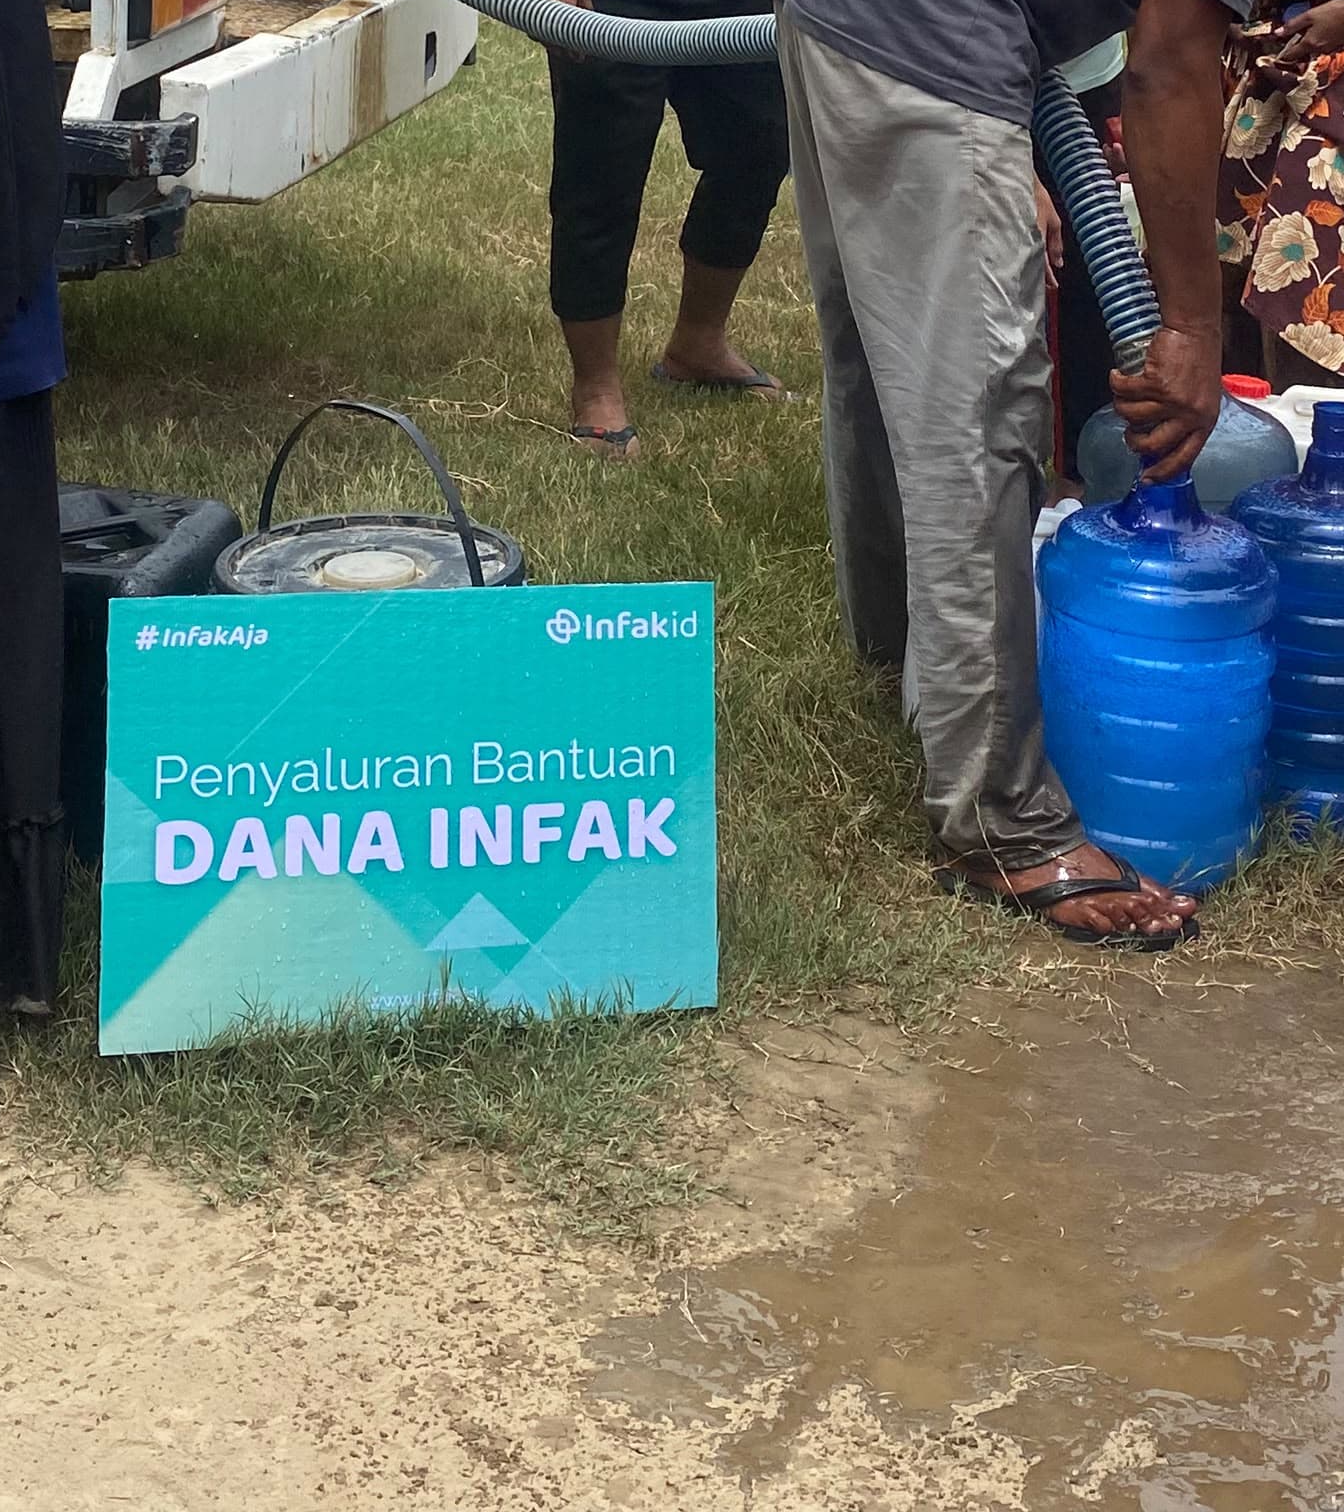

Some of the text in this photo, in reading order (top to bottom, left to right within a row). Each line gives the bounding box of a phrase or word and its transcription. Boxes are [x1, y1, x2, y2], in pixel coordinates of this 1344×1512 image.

[155, 738, 677, 808] Penyaluran Bantuan
[155, 797, 679, 886] DANA INFAK
